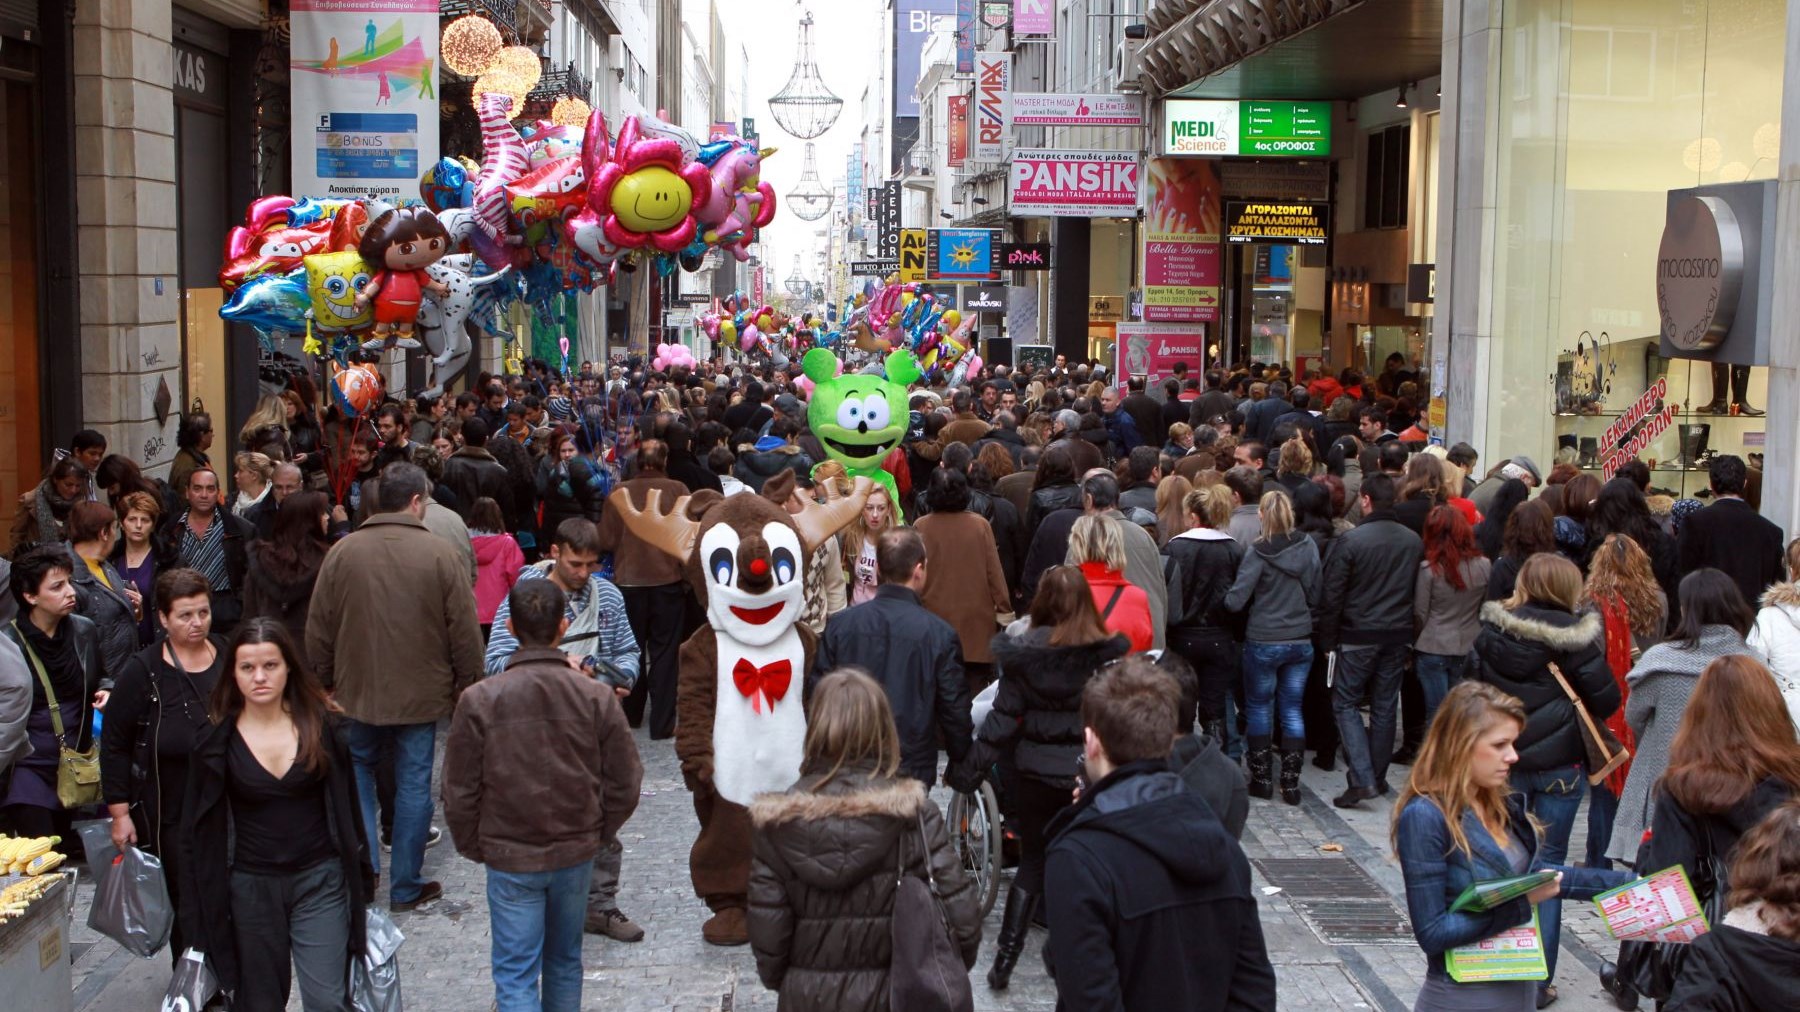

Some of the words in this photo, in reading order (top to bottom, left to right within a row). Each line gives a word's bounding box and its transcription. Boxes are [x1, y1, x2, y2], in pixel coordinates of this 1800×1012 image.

[979, 60, 1003, 144] RE/MAX
[1014, 98, 1041, 107] MASTER
[1171, 121, 1214, 139] MEDI
[1177, 138, 1226, 151] Science
[1254, 141, 1272, 151] 4ος
[1273, 141, 1315, 151] ΟΡΟΦΟΣ
[1017, 152, 1061, 161] Ανώτερες
[1063, 153, 1103, 161] σπουδές
[1105, 154, 1133, 162] μόδας
[328, 184, 368, 194] Αποκτήστε
[370, 186, 390, 195] τώρα
[1066, 190, 1091, 198] ITALIA
[1245, 205, 1313, 215] ΑΓΟΡΑΖΟΝΤΑΙ
[1238, 215, 1318, 226] ΑΝΤΑΛΛΑΣΟΝΤΑΙ
[1230, 226, 1262, 236] ΧΡΥΣΑ
[1264, 226, 1325, 237] ΚΟΣΜΗΜΑΤΑ
[1149, 243, 1177, 254] Bella
[1181, 245, 1214, 254] Donna
[1659, 257, 1719, 279] mocassino
[968, 300, 1002, 308] SWAROVSKI
[1601, 376, 1667, 457] ΔΕΚΑΗΜΕΡΟ
[1602, 408, 1673, 484] ΠΡΟΣΦΟΡΩΝ
